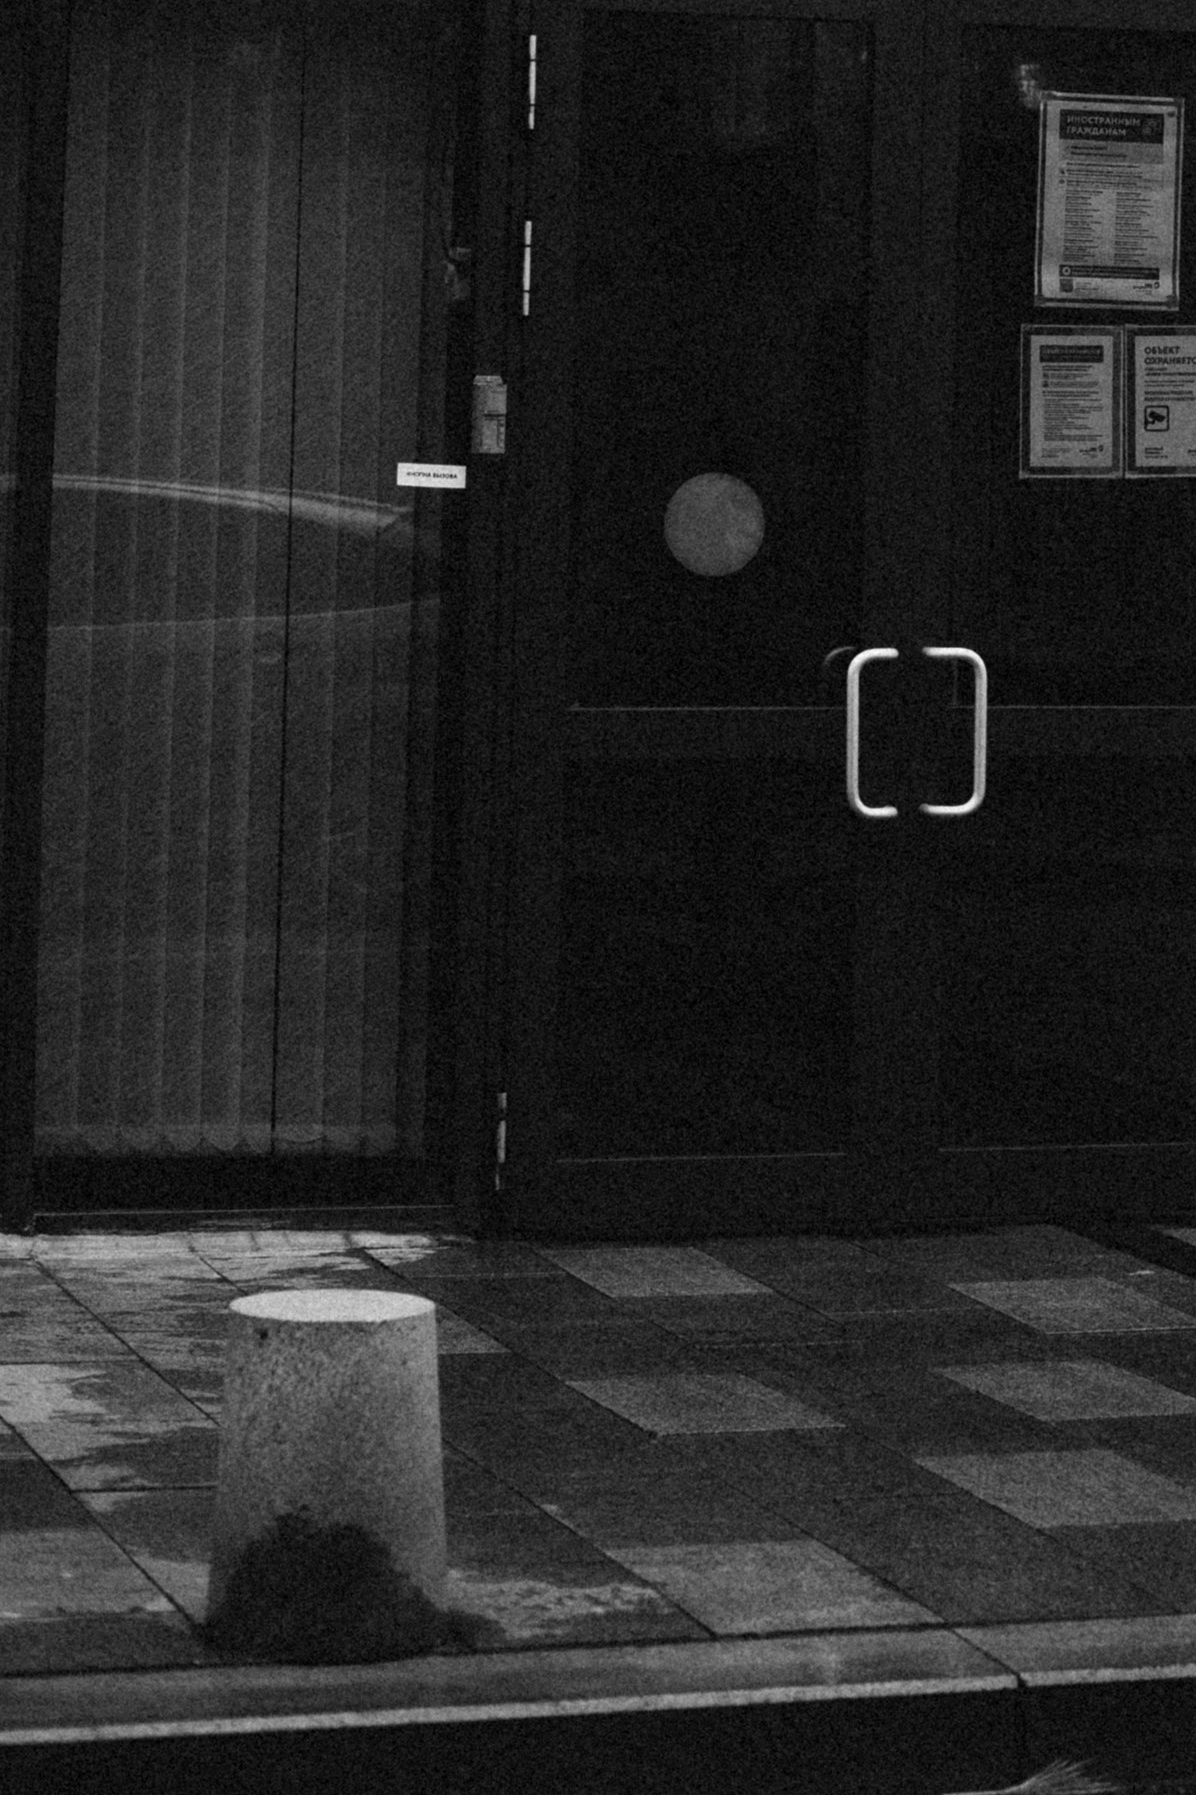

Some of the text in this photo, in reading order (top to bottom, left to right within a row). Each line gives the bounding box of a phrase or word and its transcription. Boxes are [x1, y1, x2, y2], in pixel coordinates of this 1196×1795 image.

[1066, 114, 1141, 127] ИНОСТРАННЫМ
[1066, 125, 1127, 136] ГРАЖДАНАМ
[1144, 345, 1180, 355] ОБЪЕКТ
